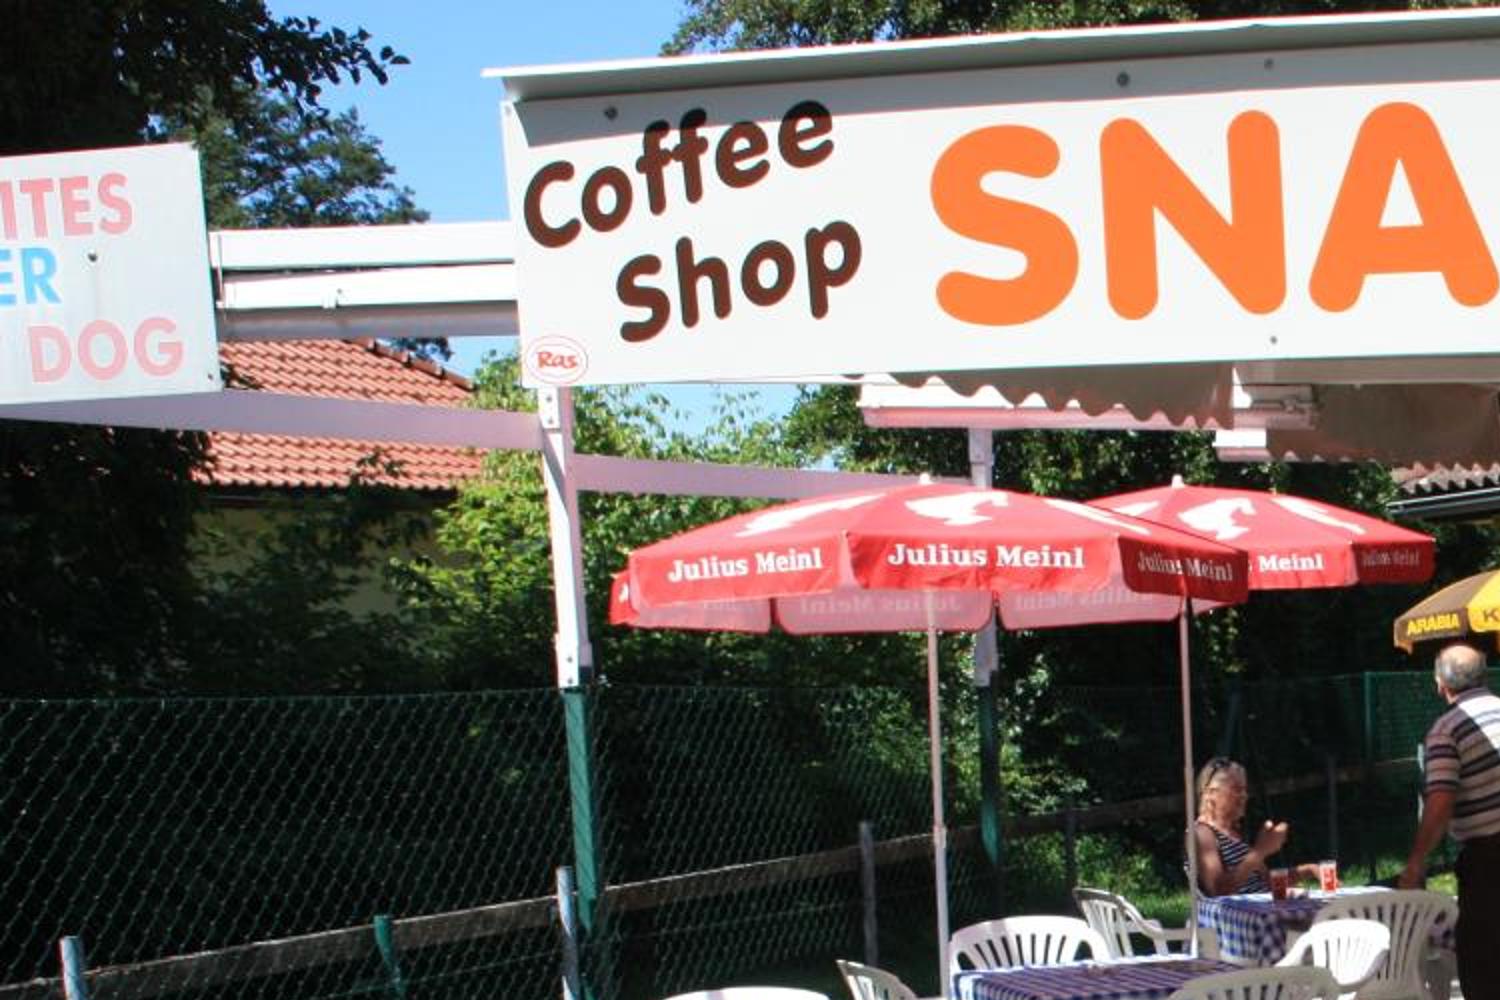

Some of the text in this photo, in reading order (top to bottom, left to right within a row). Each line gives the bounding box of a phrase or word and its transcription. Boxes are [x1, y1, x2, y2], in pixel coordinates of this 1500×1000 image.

[524, 99, 835, 249] Coffee
[616, 220, 862, 343] Shop
[28, 316, 184, 383] DOG
[537, 351, 578, 369] Ras
[668, 548, 822, 582] Julius Meinl
[887, 543, 1085, 569] Julius Meinl
[1258, 552, 1324, 573] Meinl
[1185, 557, 1234, 582] Meinl
[1407, 612, 1459, 636] ARABIA
